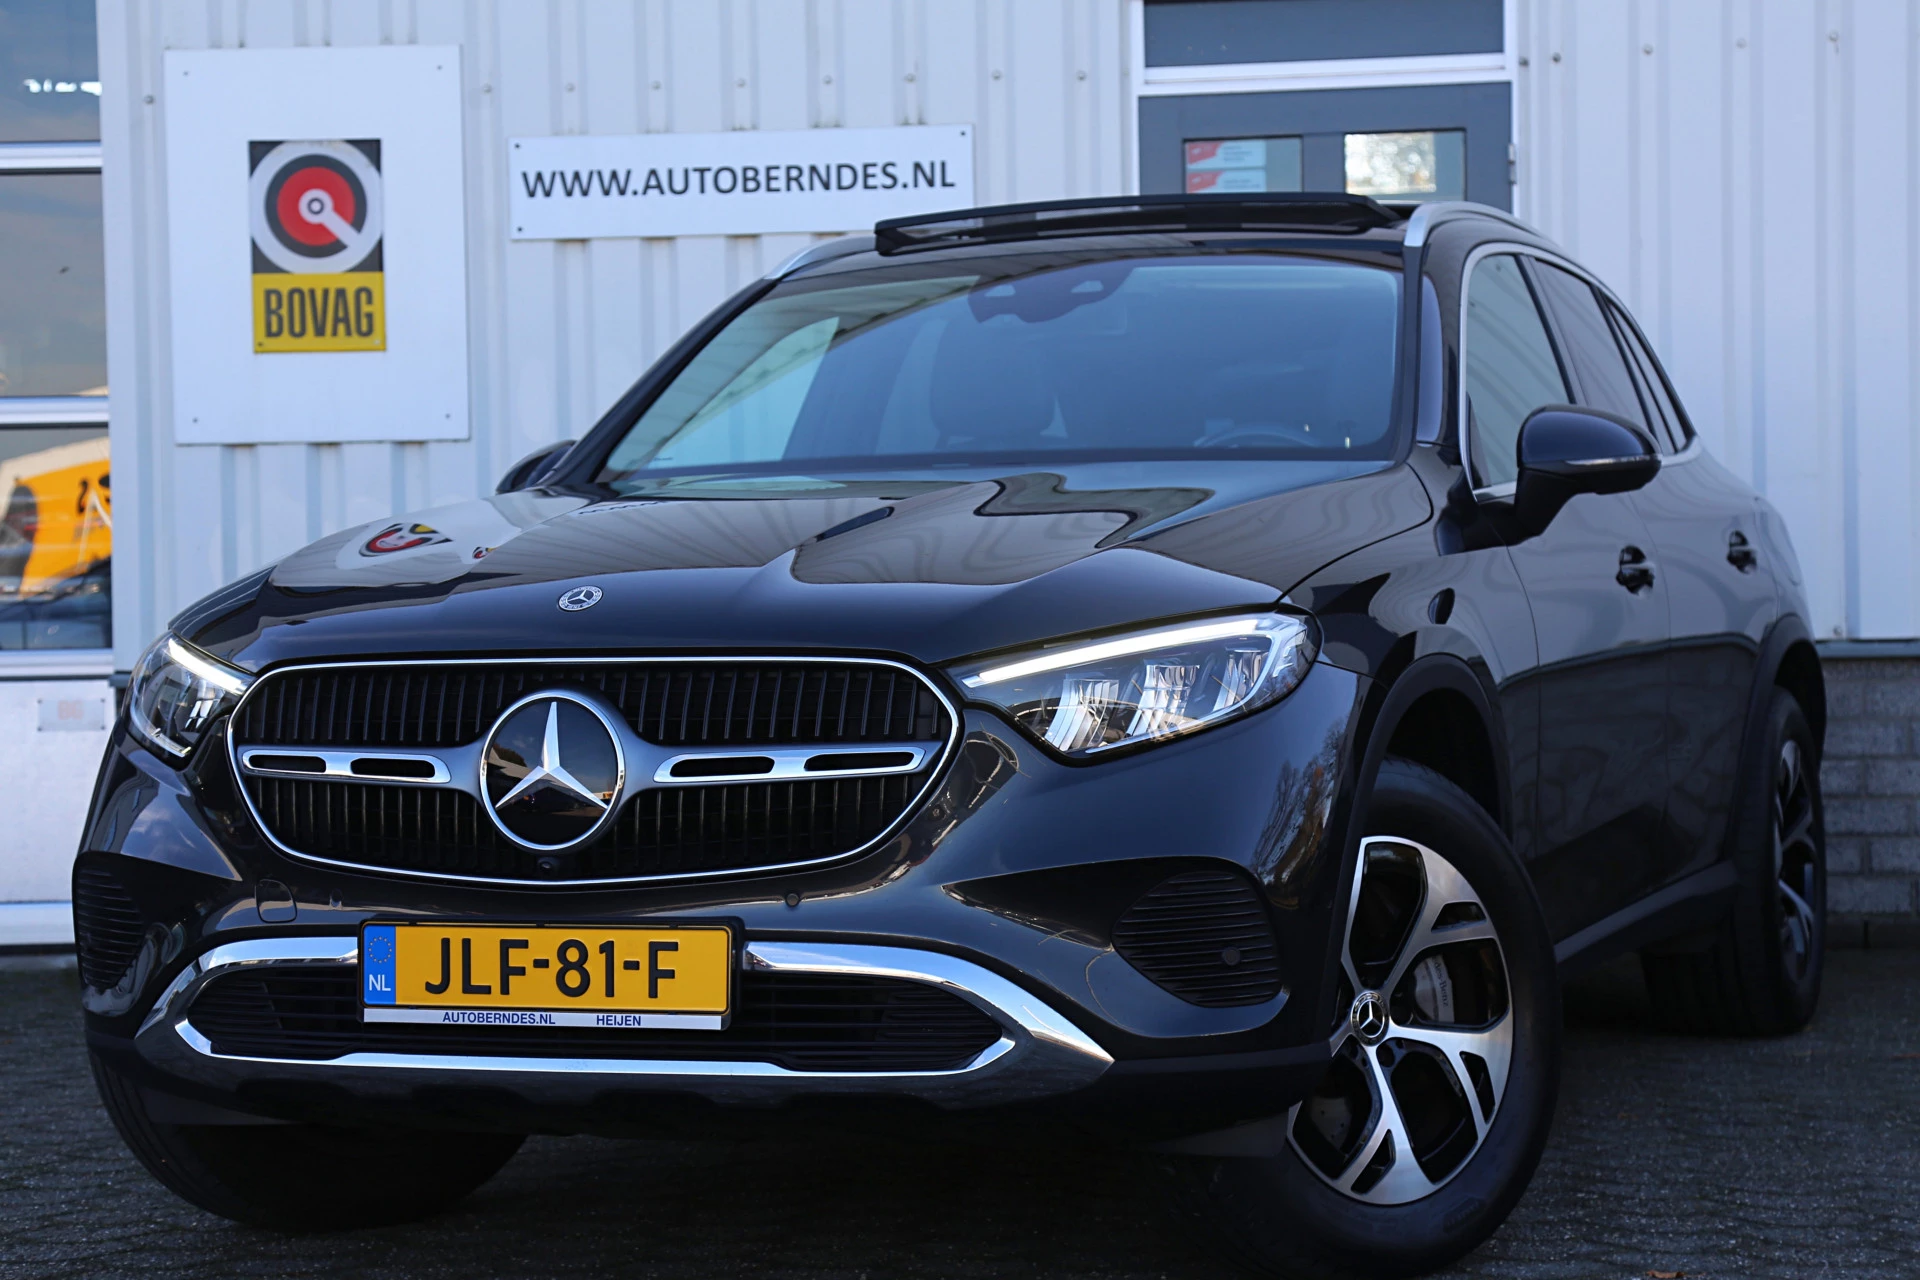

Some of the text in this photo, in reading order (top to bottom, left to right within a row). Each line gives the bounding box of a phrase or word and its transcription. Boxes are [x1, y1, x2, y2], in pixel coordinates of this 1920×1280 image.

[522, 160, 956, 198] WWW.AUTOBERNDES.NL
[264, 286, 375, 338] BOVAG
[368, 973, 392, 992] NL
[424, 937, 679, 999] JLF-81-F
[442, 1012, 642, 1027] AUTOBERNDES.NL HEIJEN
